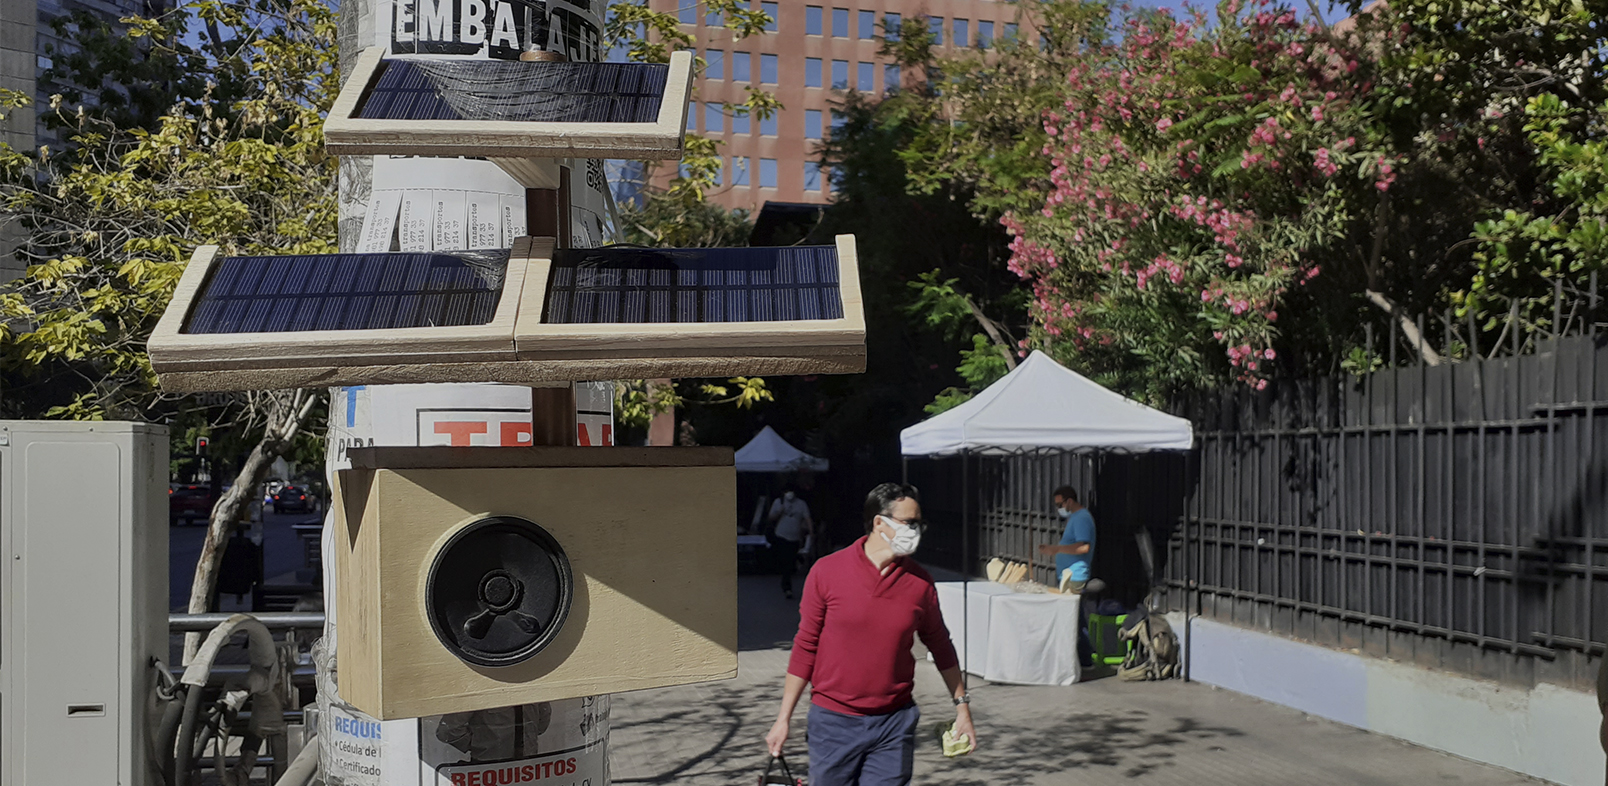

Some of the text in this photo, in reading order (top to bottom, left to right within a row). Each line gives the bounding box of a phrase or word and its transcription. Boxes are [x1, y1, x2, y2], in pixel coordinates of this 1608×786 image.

[339, 740, 363, 755] Cédula
[365, 746, 377, 758] de
[340, 758, 381, 776] Certificado
[450, 757, 577, 786] REQUISITOS
